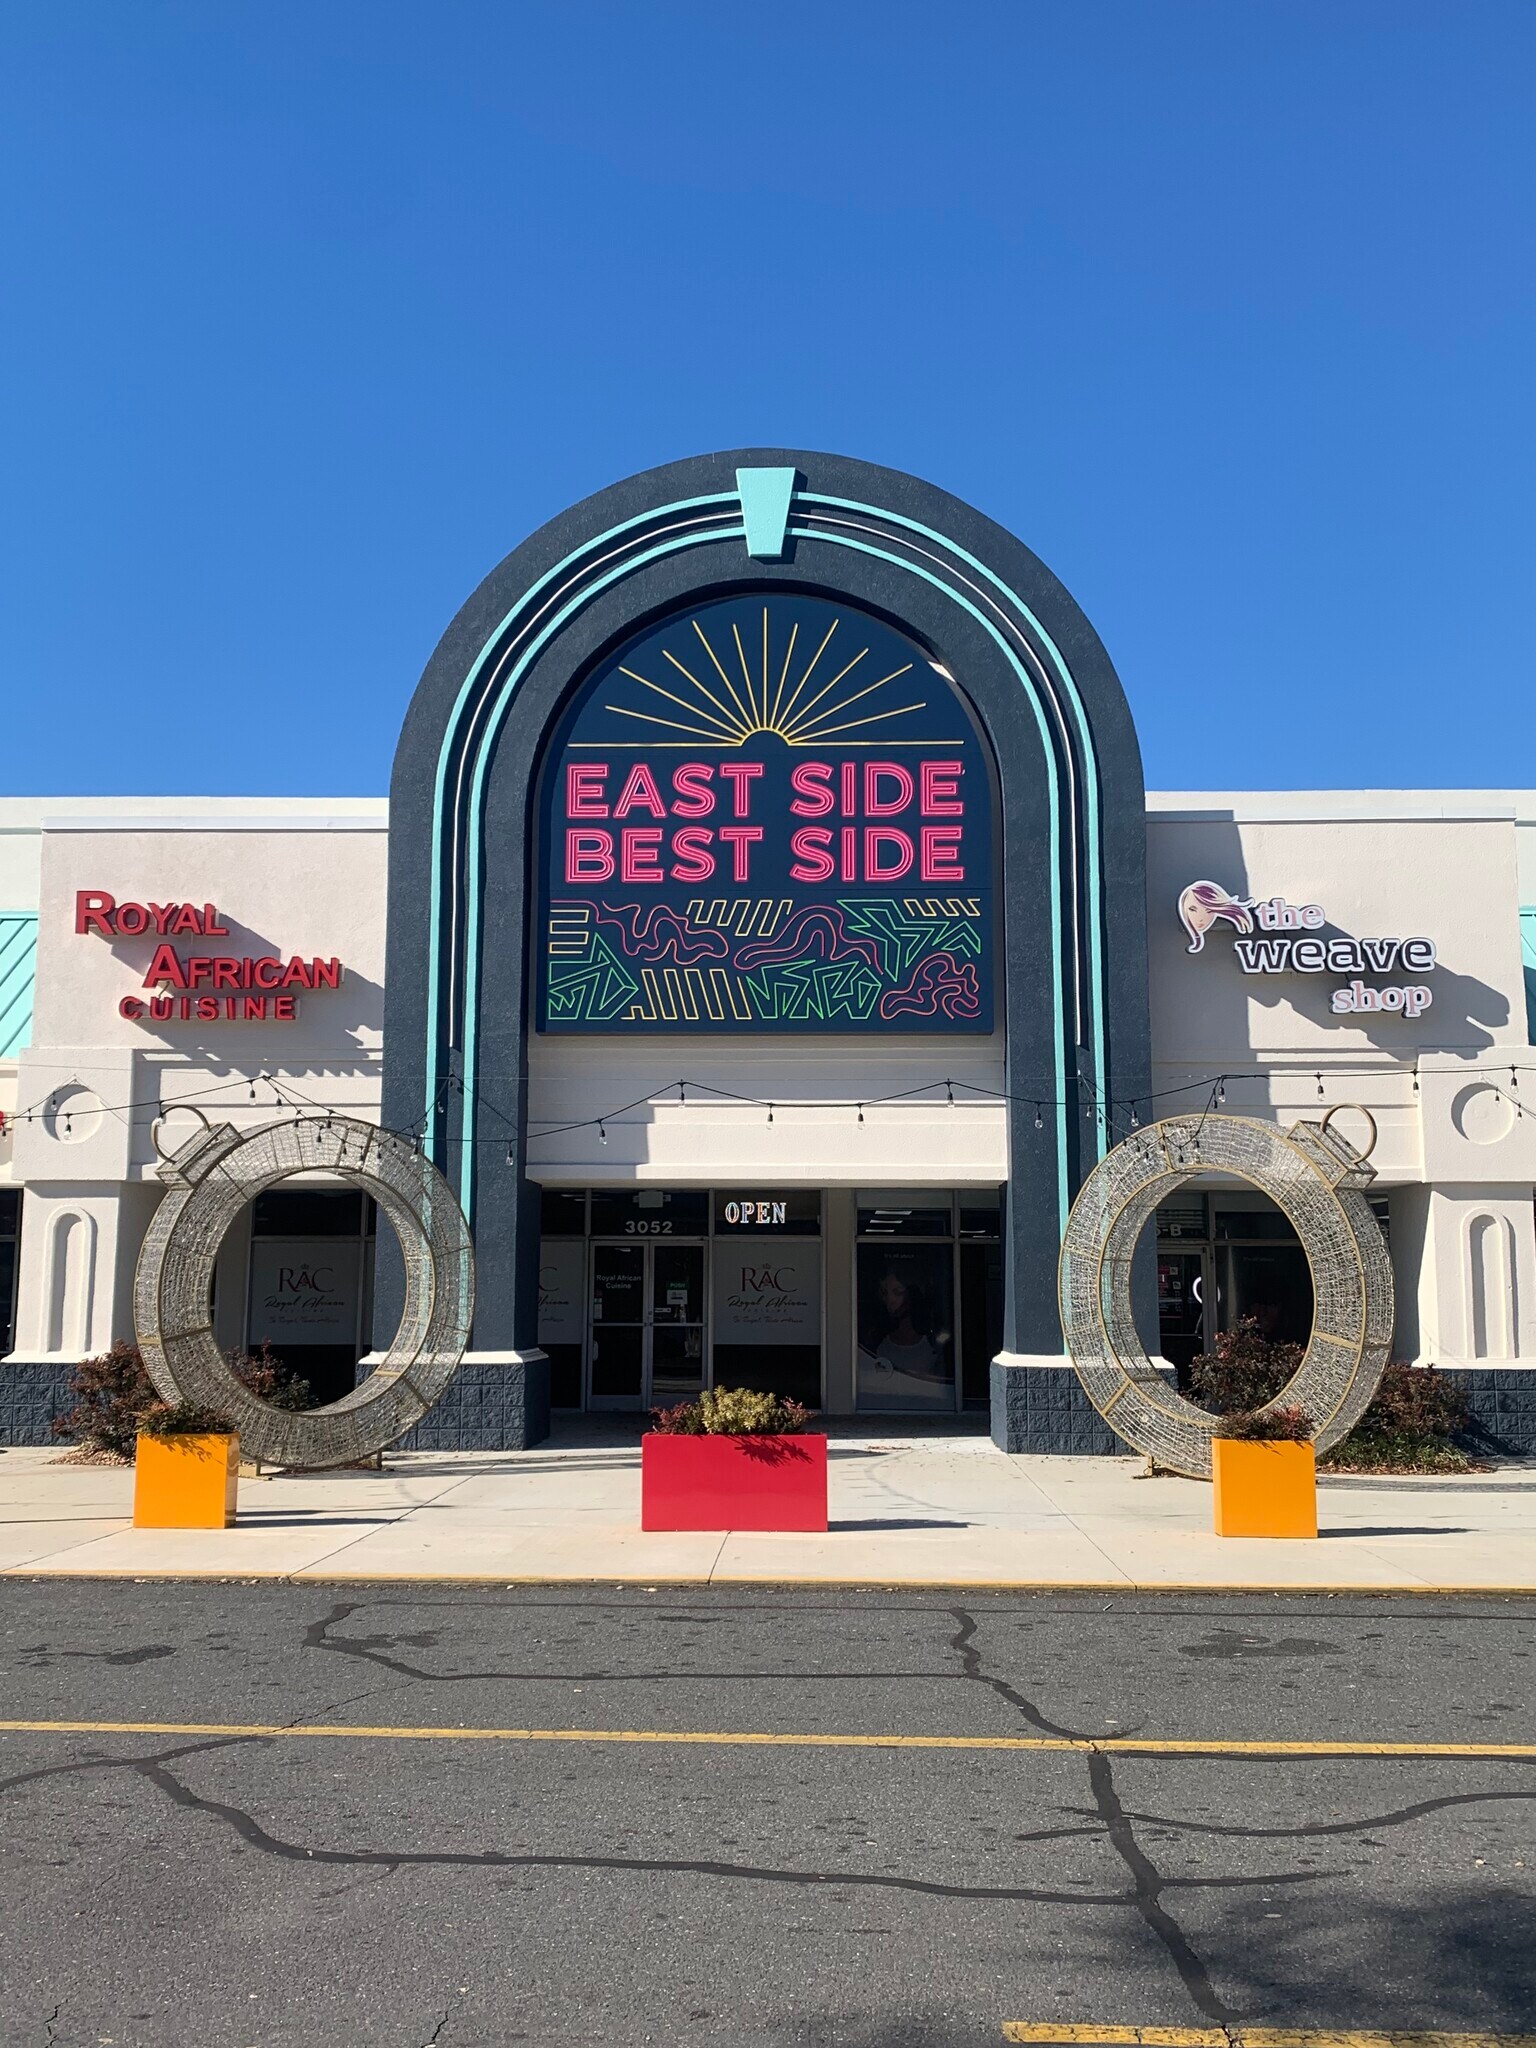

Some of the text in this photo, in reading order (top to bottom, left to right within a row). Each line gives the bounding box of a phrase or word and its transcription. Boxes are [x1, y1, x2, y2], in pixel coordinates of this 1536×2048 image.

[567, 762, 963, 817] EAST SIDE
[566, 826, 964, 882] BEST SIDE
[1257, 900, 1326, 931] the
[1234, 937, 1437, 975] weave
[119, 996, 295, 1020] CUISINE
[1331, 981, 1434, 1019] shop
[725, 1202, 786, 1223] OPEN
[625, 1220, 673, 1234] 3052
[278, 1267, 335, 1293] RAC
[740, 1267, 799, 1293] RAC
[263, 1295, 345, 1312] Royal African
[727, 1295, 809, 1311] Royal African
